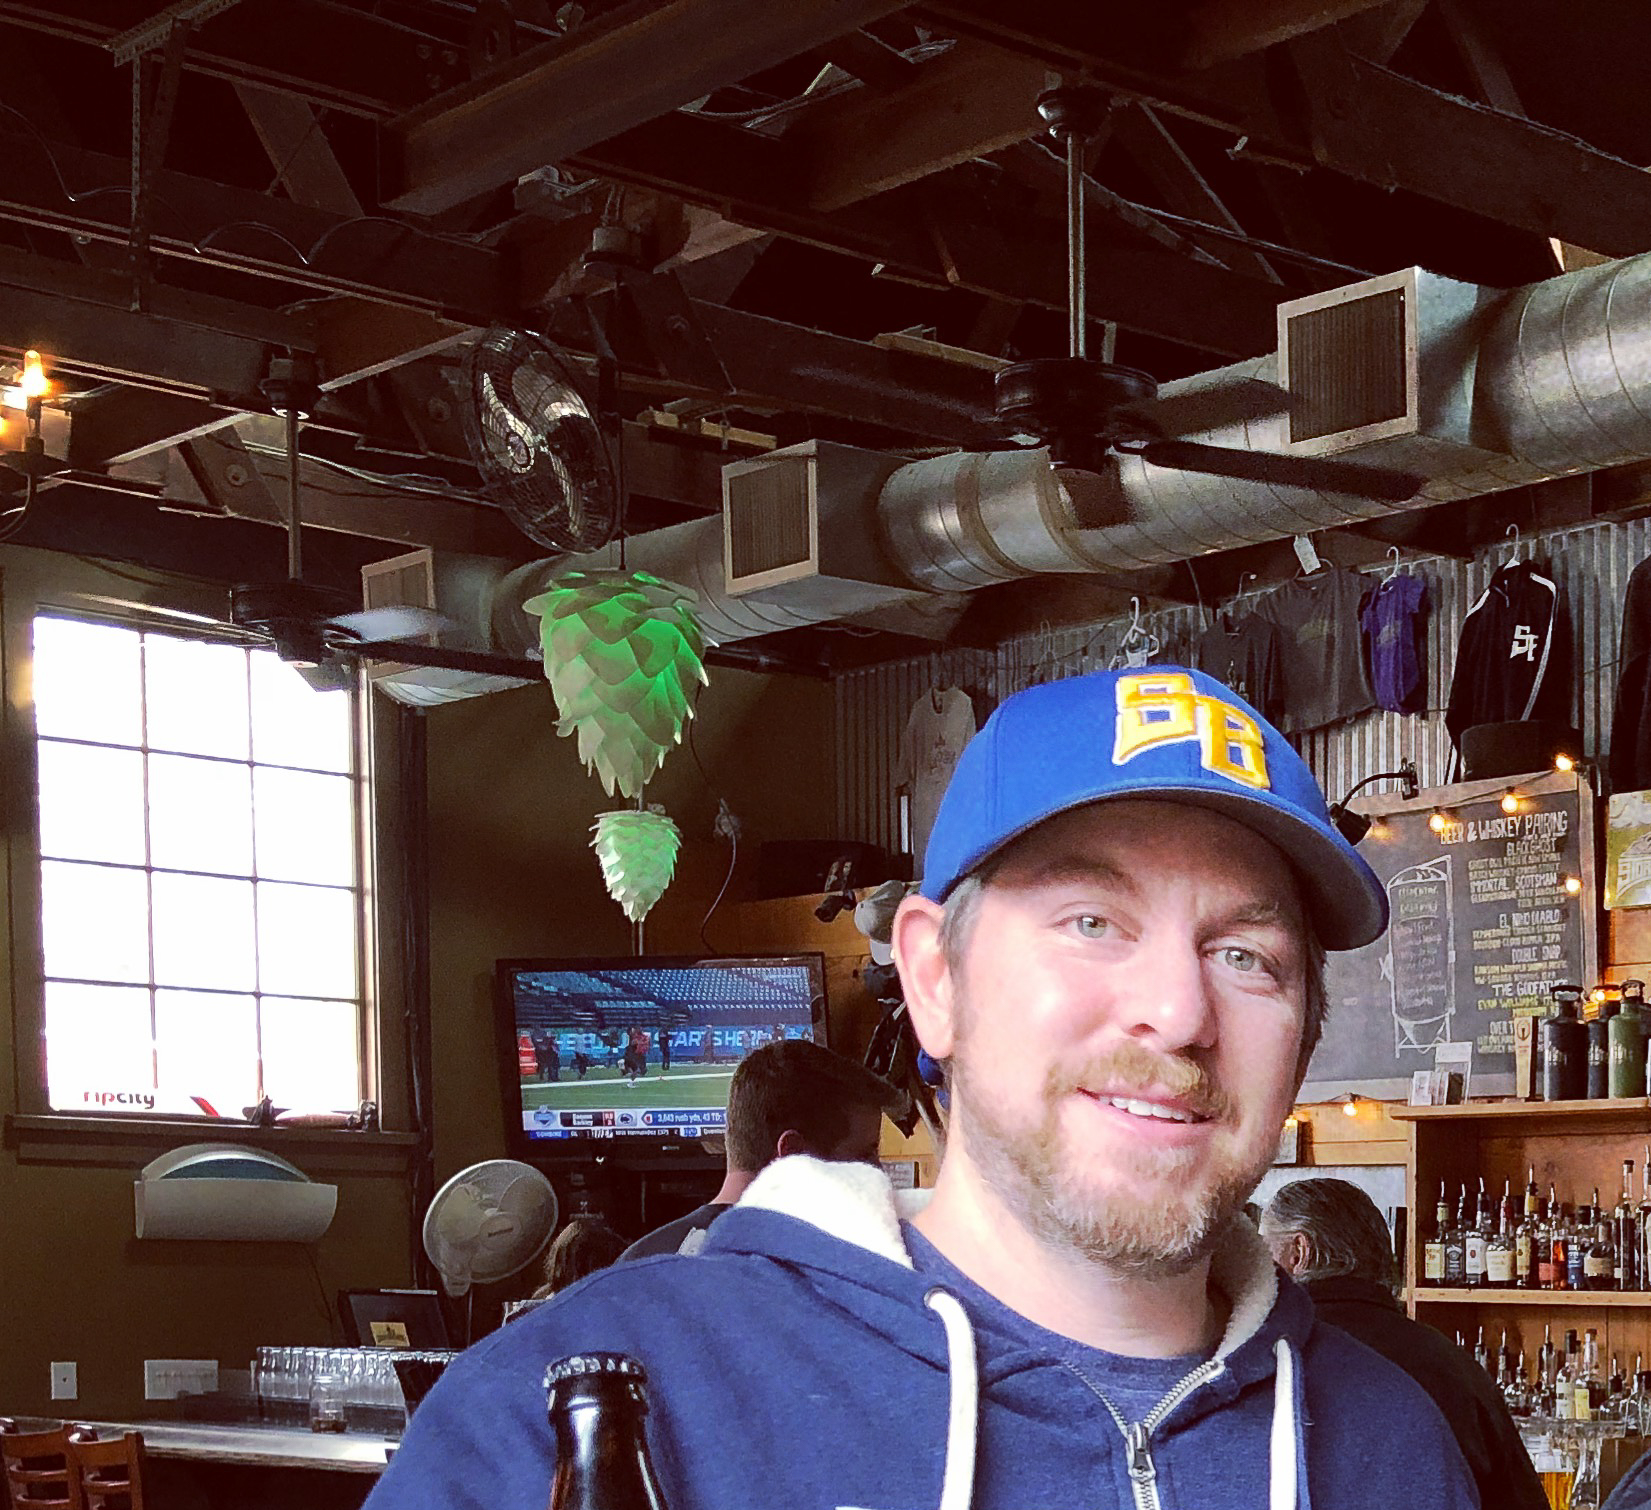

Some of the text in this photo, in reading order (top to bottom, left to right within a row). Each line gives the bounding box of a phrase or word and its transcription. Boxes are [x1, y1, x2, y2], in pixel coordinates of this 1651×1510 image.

[1112, 672, 1272, 790] SB
[1467, 821, 1478, 842] &
[1478, 815, 1522, 840] WHISKEY
[1515, 872, 1558, 890] SCOTSMAN
